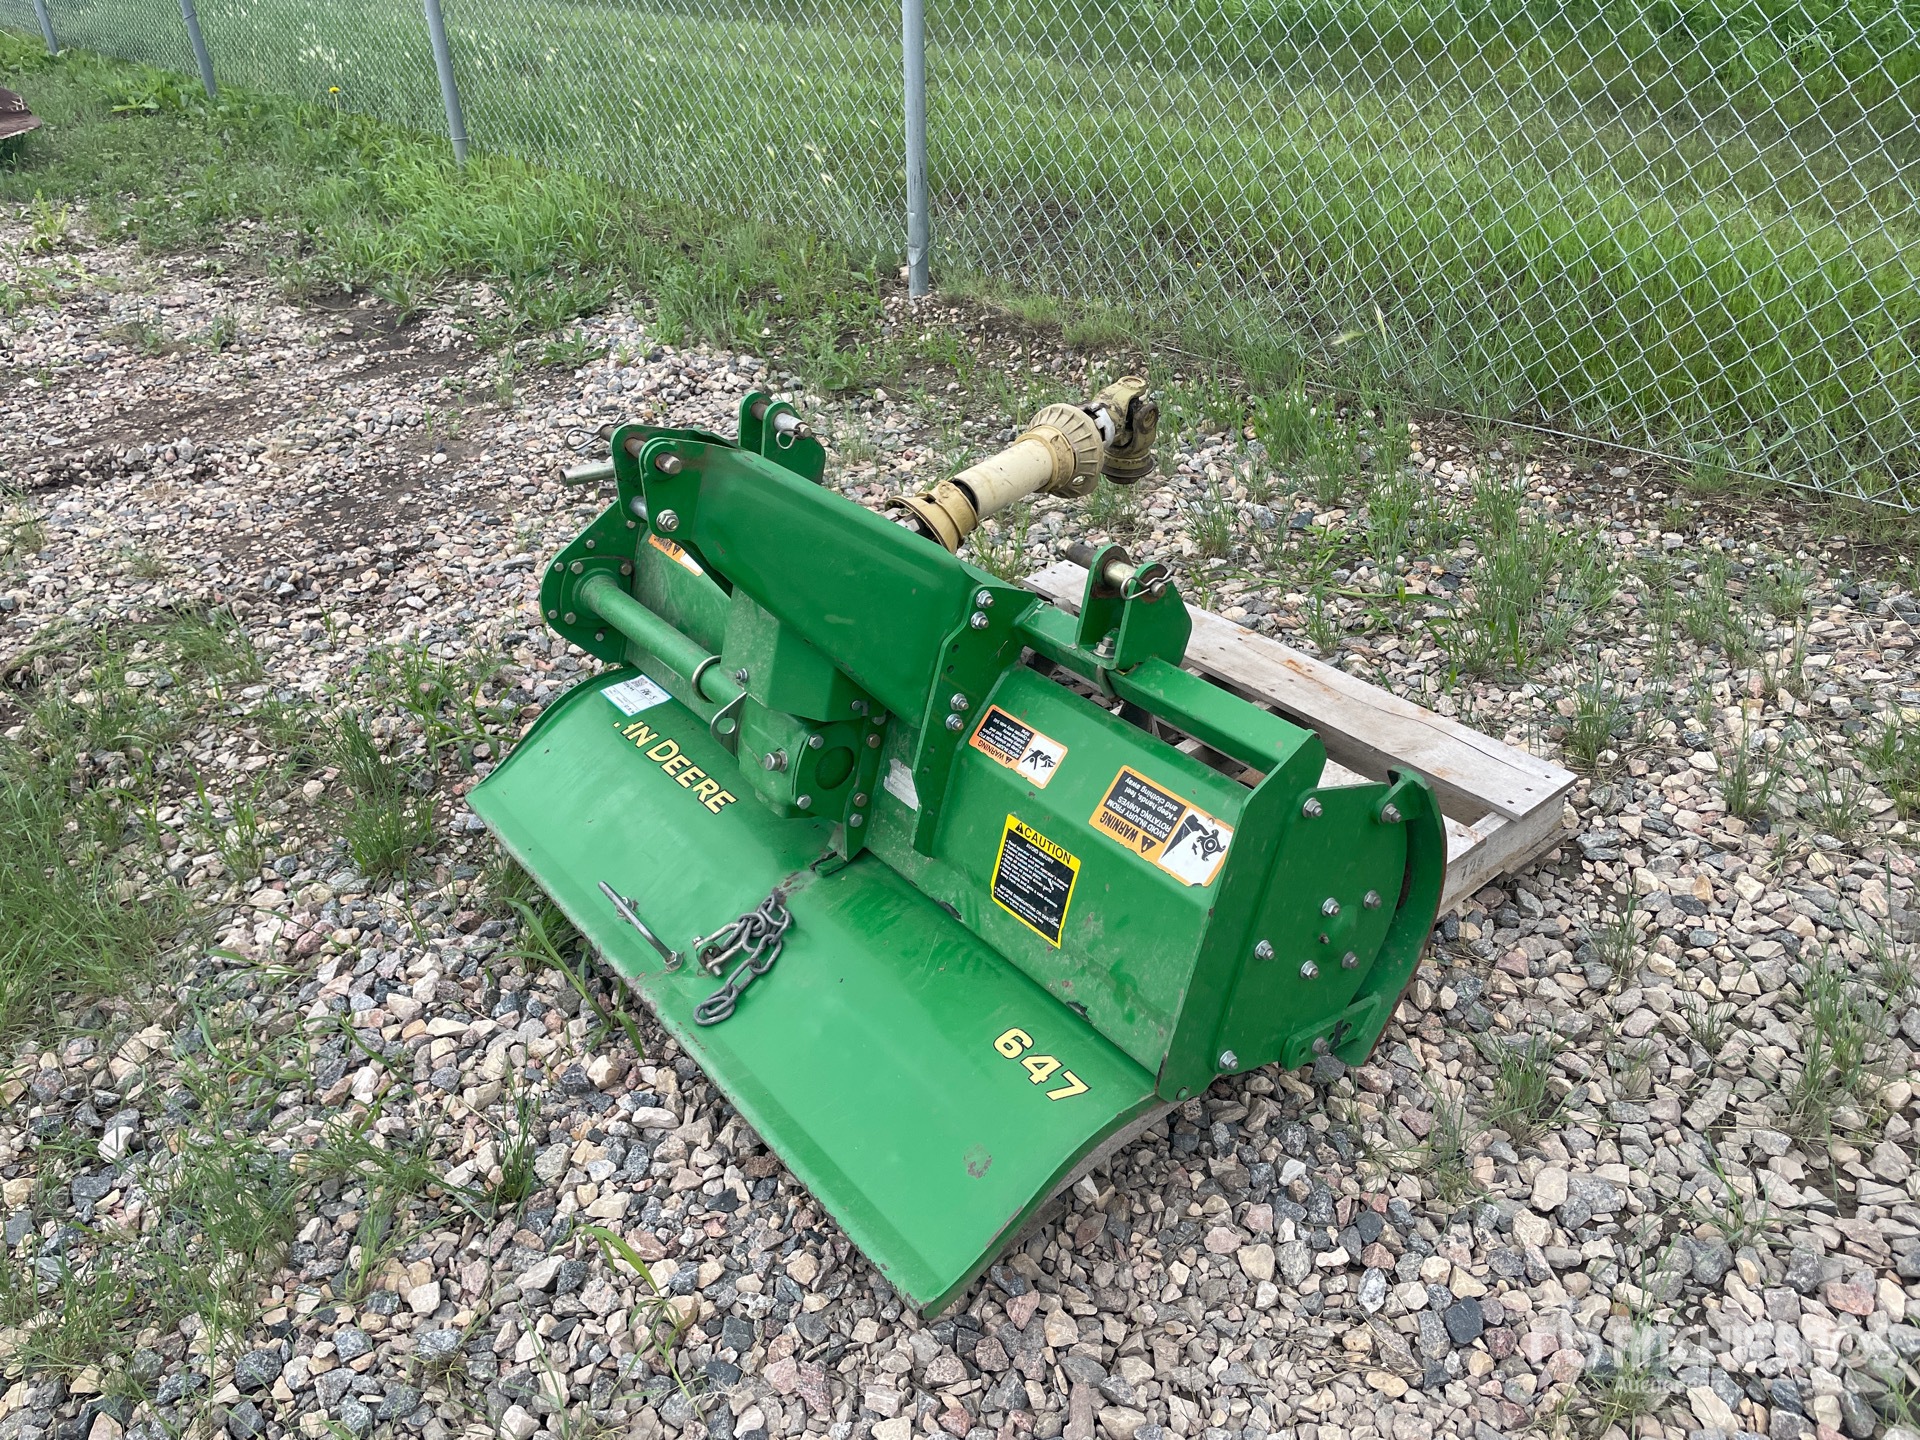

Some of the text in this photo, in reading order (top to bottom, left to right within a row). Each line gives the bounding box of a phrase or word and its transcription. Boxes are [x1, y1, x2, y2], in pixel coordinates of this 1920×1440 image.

[977, 739, 1005, 760] WARNING
[644, 738, 739, 815] DEERE
[1124, 775, 1178, 812] and clothing away
[1106, 798, 1167, 839] AVOID INJURY FROM
[1116, 795, 1172, 832] ROTATING KNIVES
[1123, 786, 1174, 820] Keep hands, feet
[1098, 810, 1139, 842] WARNING
[1023, 826, 1071, 865] CAUTION
[993, 1027, 1091, 1101] 647
